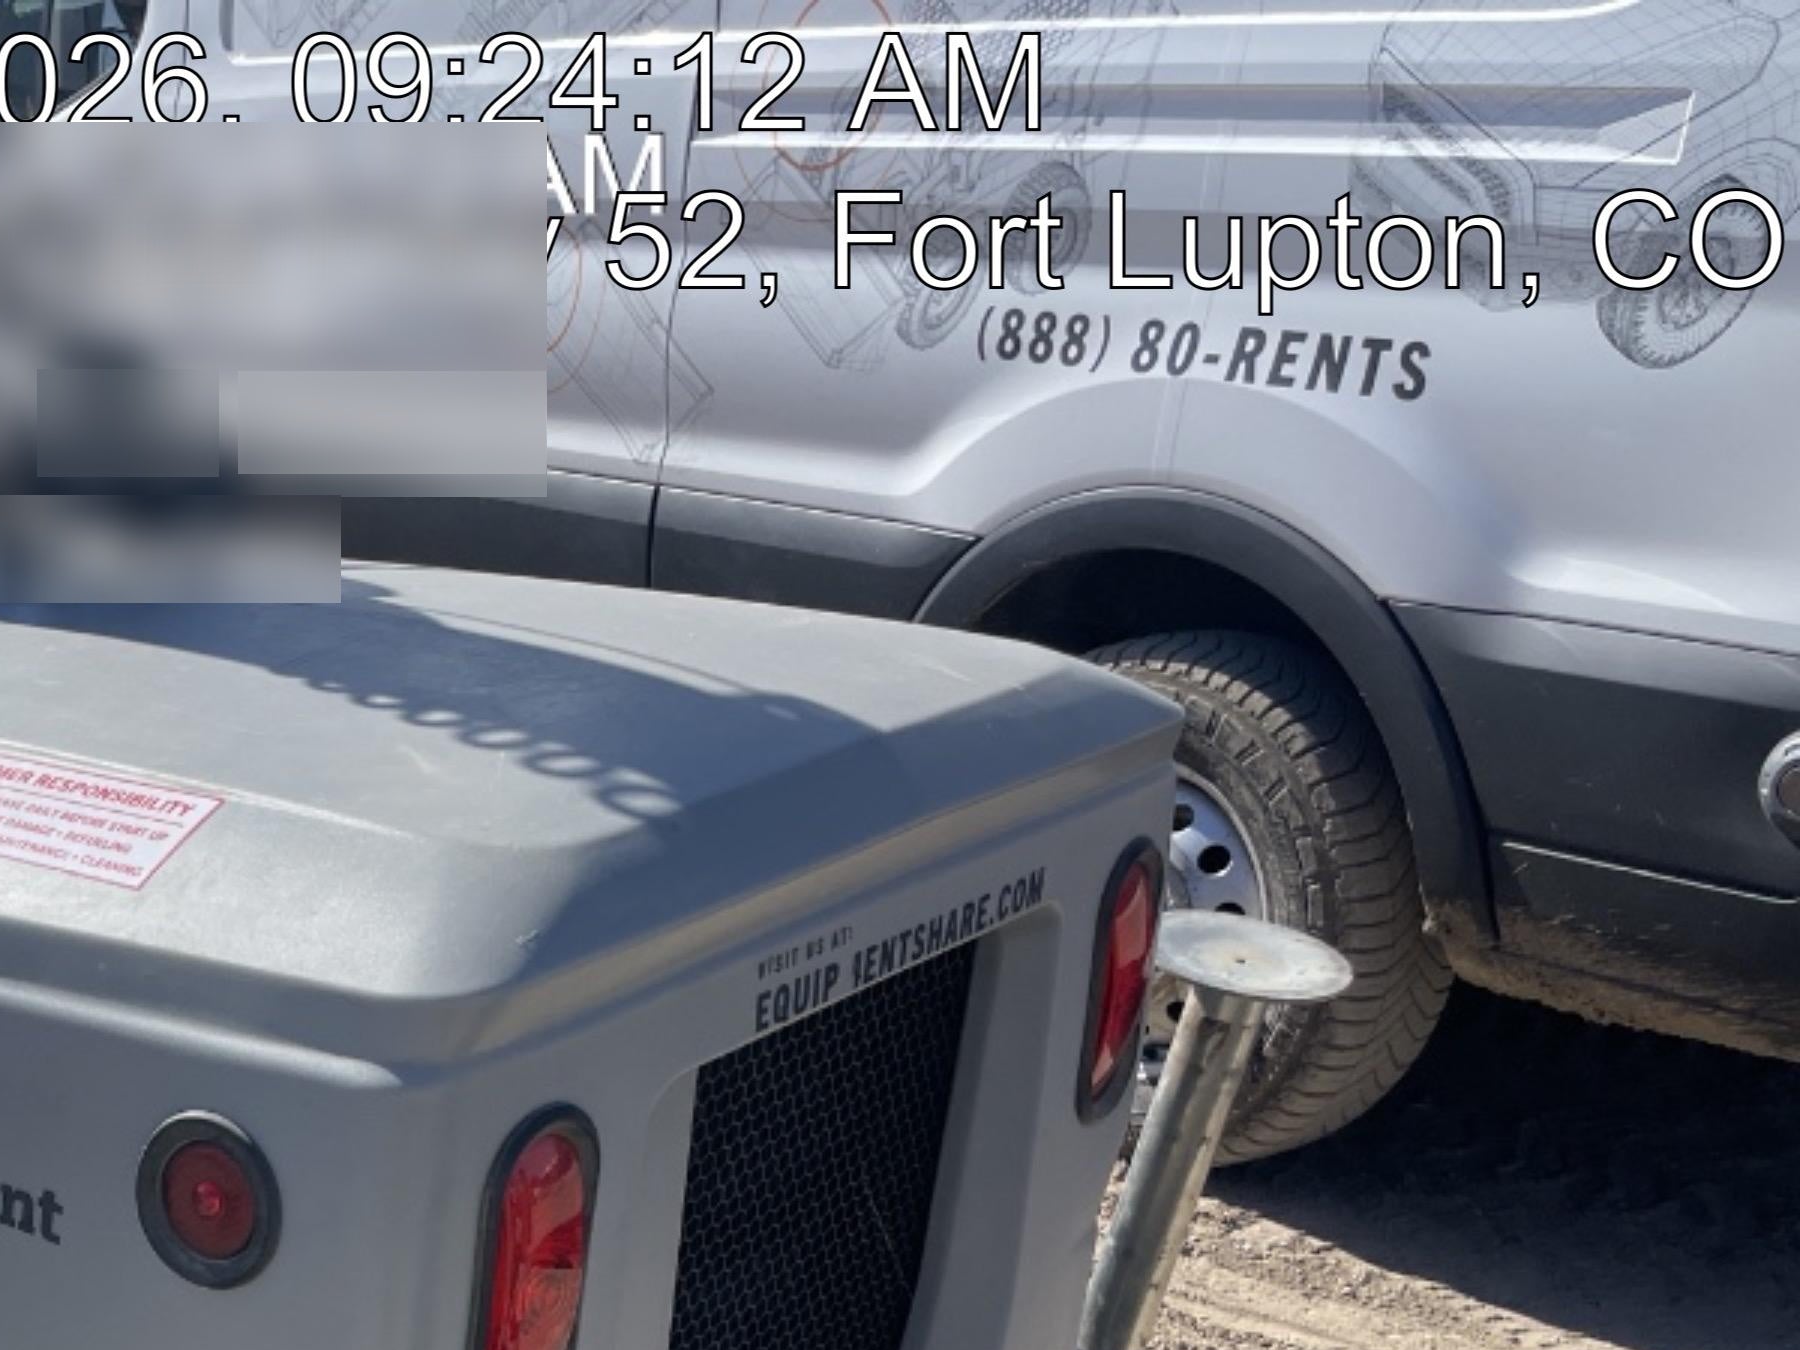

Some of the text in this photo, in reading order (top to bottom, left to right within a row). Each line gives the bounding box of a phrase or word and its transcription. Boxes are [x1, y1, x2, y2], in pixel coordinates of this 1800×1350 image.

[976, 307, 1431, 402] (888) 80-RENTS
[33, 772, 196, 818] RESPONSIBILITY
[757, 947, 800, 980] VISIT
